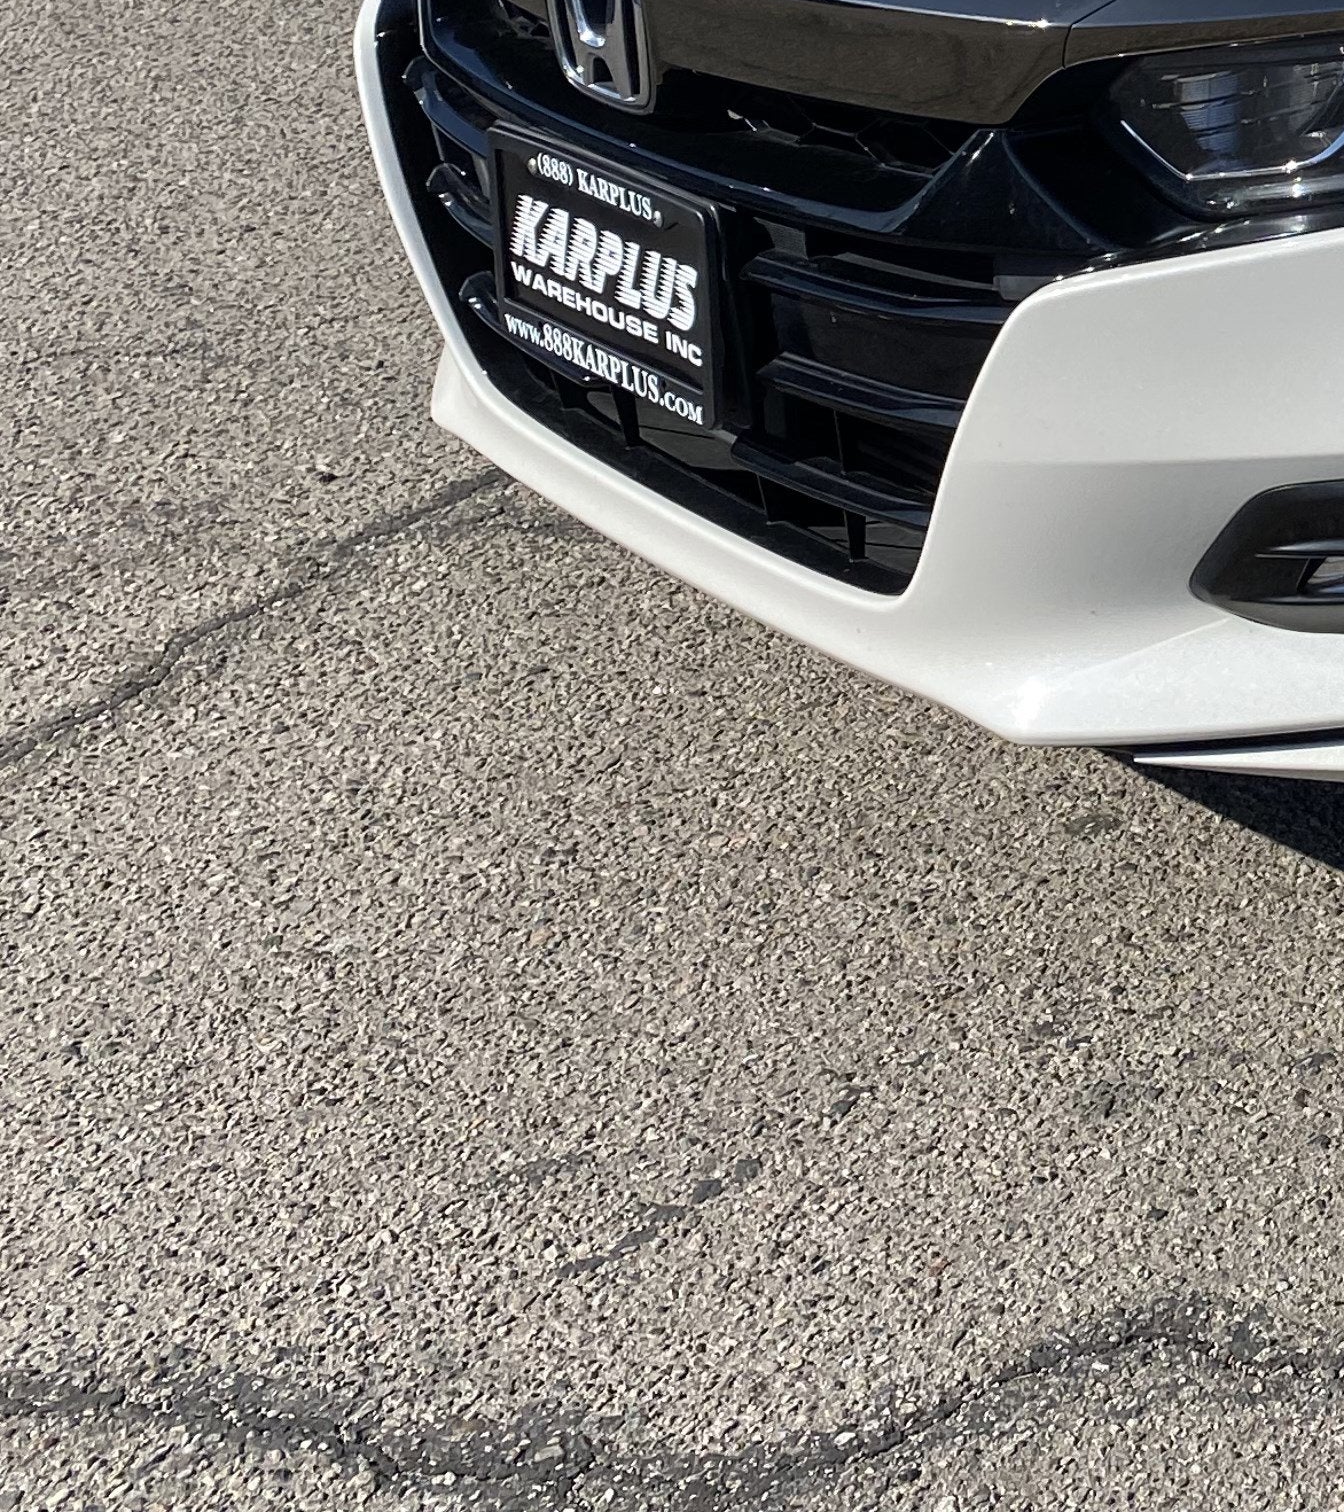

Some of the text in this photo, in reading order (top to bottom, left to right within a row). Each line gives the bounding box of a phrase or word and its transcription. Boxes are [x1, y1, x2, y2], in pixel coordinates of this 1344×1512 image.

[537, 152, 652, 220] (888) KARPLUS
[509, 194, 698, 331] KARPLUS
[511, 261, 703, 367] WAREHOUSE INC
